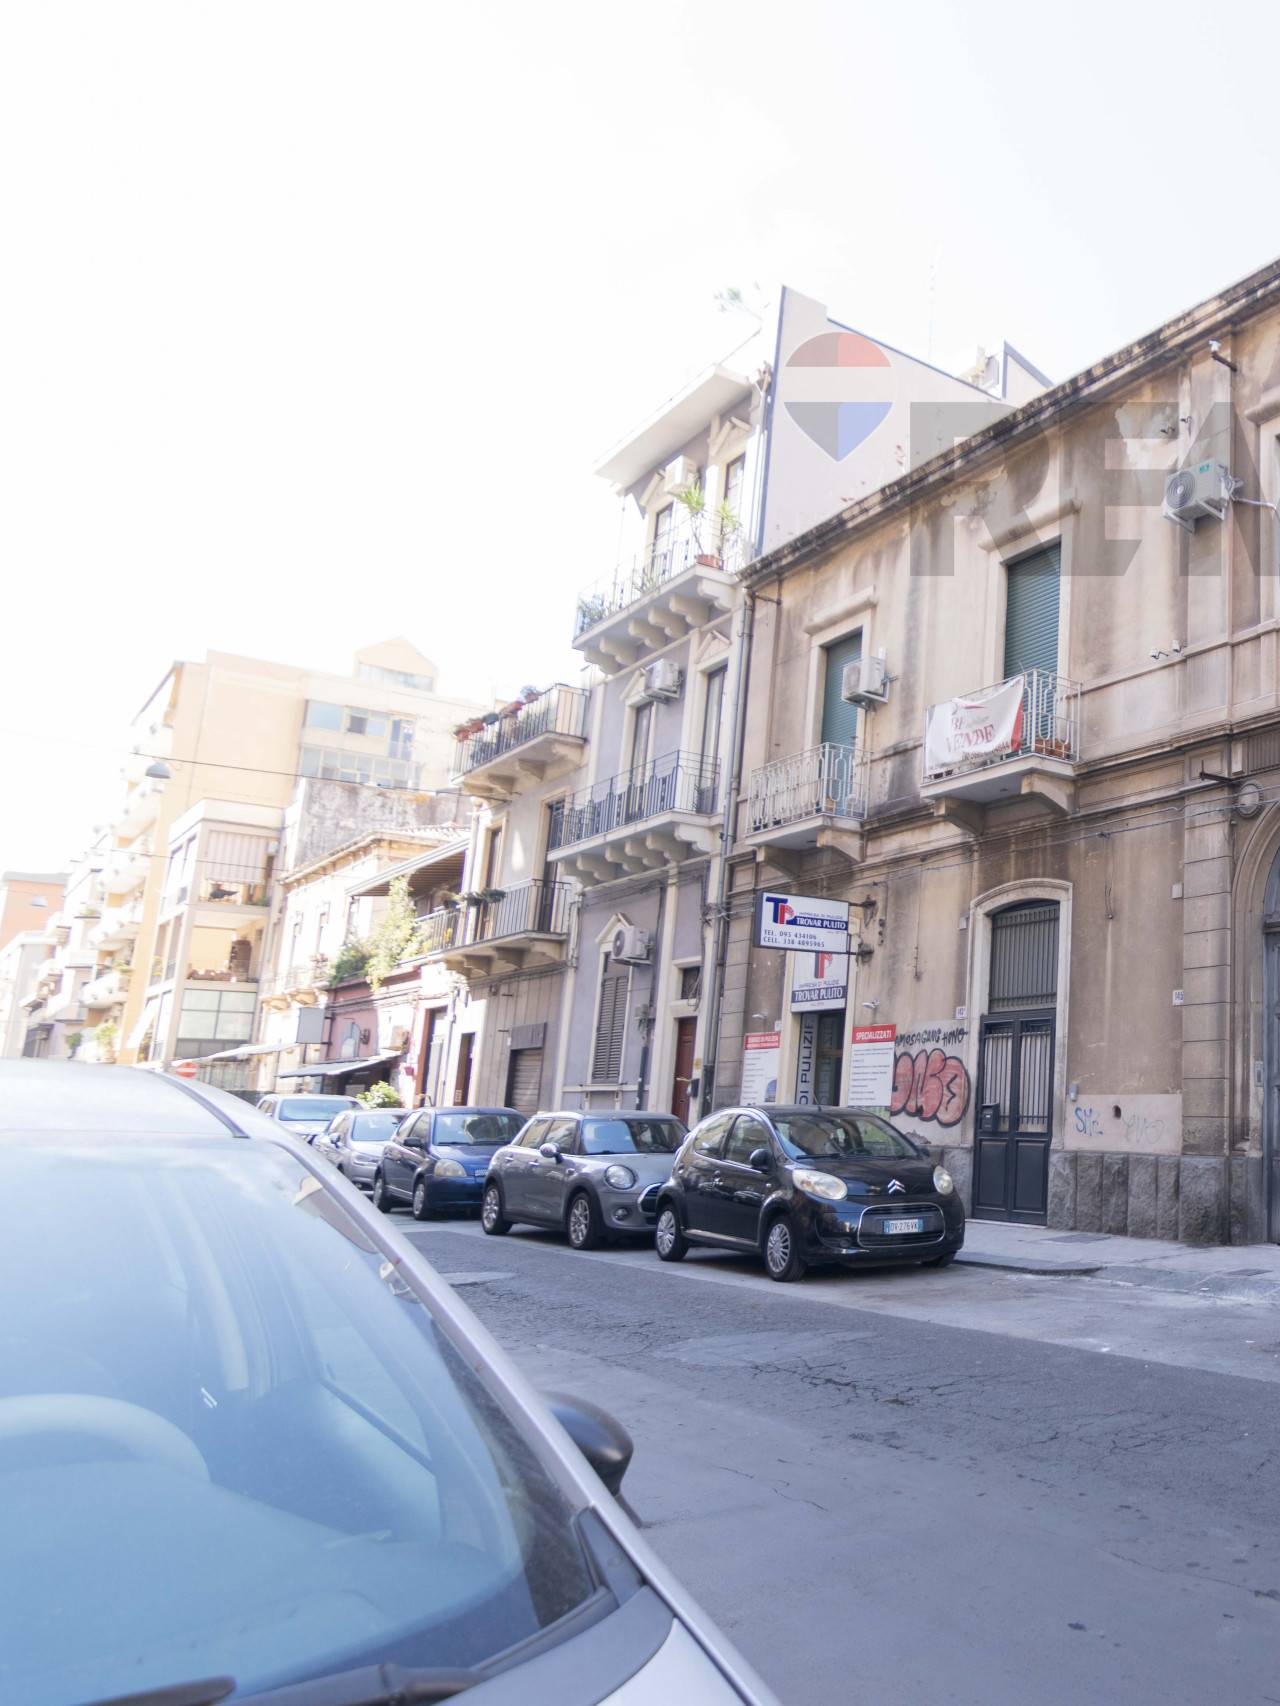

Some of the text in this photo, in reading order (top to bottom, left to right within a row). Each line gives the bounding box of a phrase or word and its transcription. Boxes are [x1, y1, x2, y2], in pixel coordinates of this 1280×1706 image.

[796, 917, 846, 930] TROVAR PULITO
[763, 929, 777, 937] TEL.
[795, 987, 843, 1001] TROVAR PULITO
